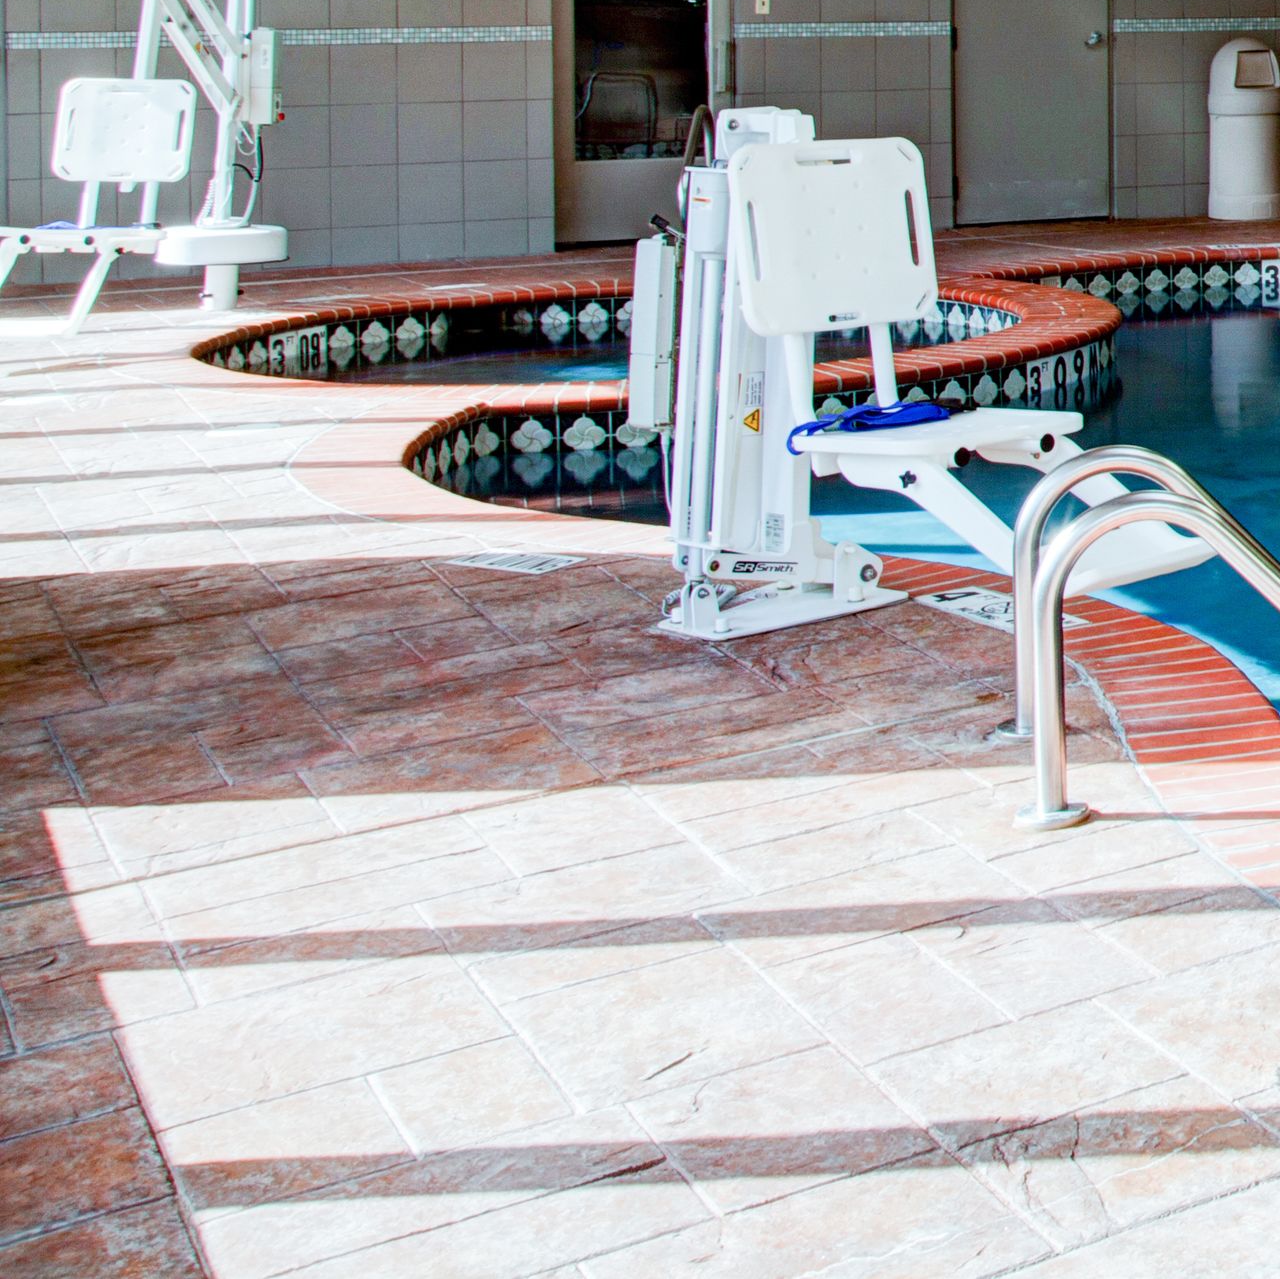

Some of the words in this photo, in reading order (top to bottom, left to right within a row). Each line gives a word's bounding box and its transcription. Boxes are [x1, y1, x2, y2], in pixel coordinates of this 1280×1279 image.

[1265, 265, 1279, 285] 3
[1030, 366, 1042, 395] 3
[757, 564, 793, 573] Smith
